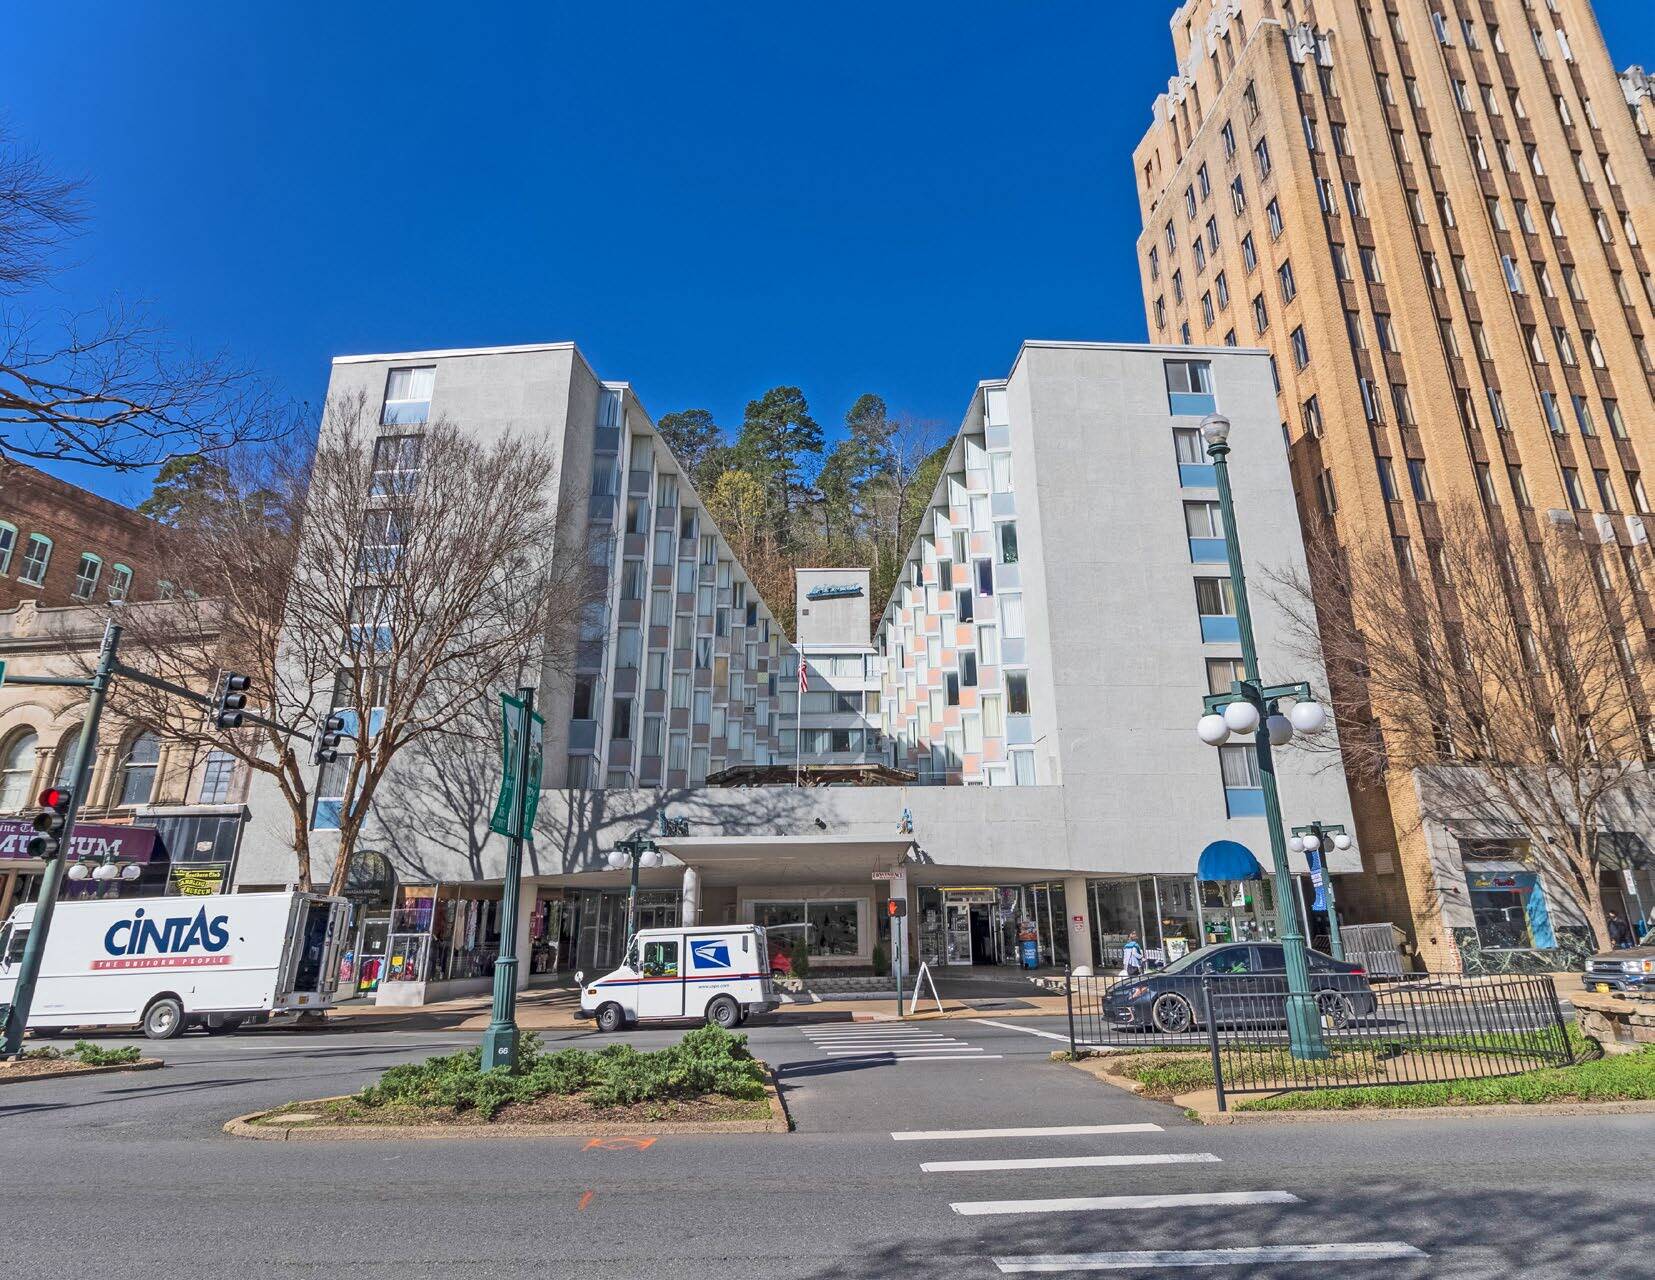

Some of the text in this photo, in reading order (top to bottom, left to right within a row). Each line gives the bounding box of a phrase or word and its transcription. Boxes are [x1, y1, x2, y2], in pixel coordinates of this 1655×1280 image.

[104, 904, 229, 956] CINTAS
[125, 959, 175, 967] UNIFORM
[182, 957, 224, 965] PEOPLE
